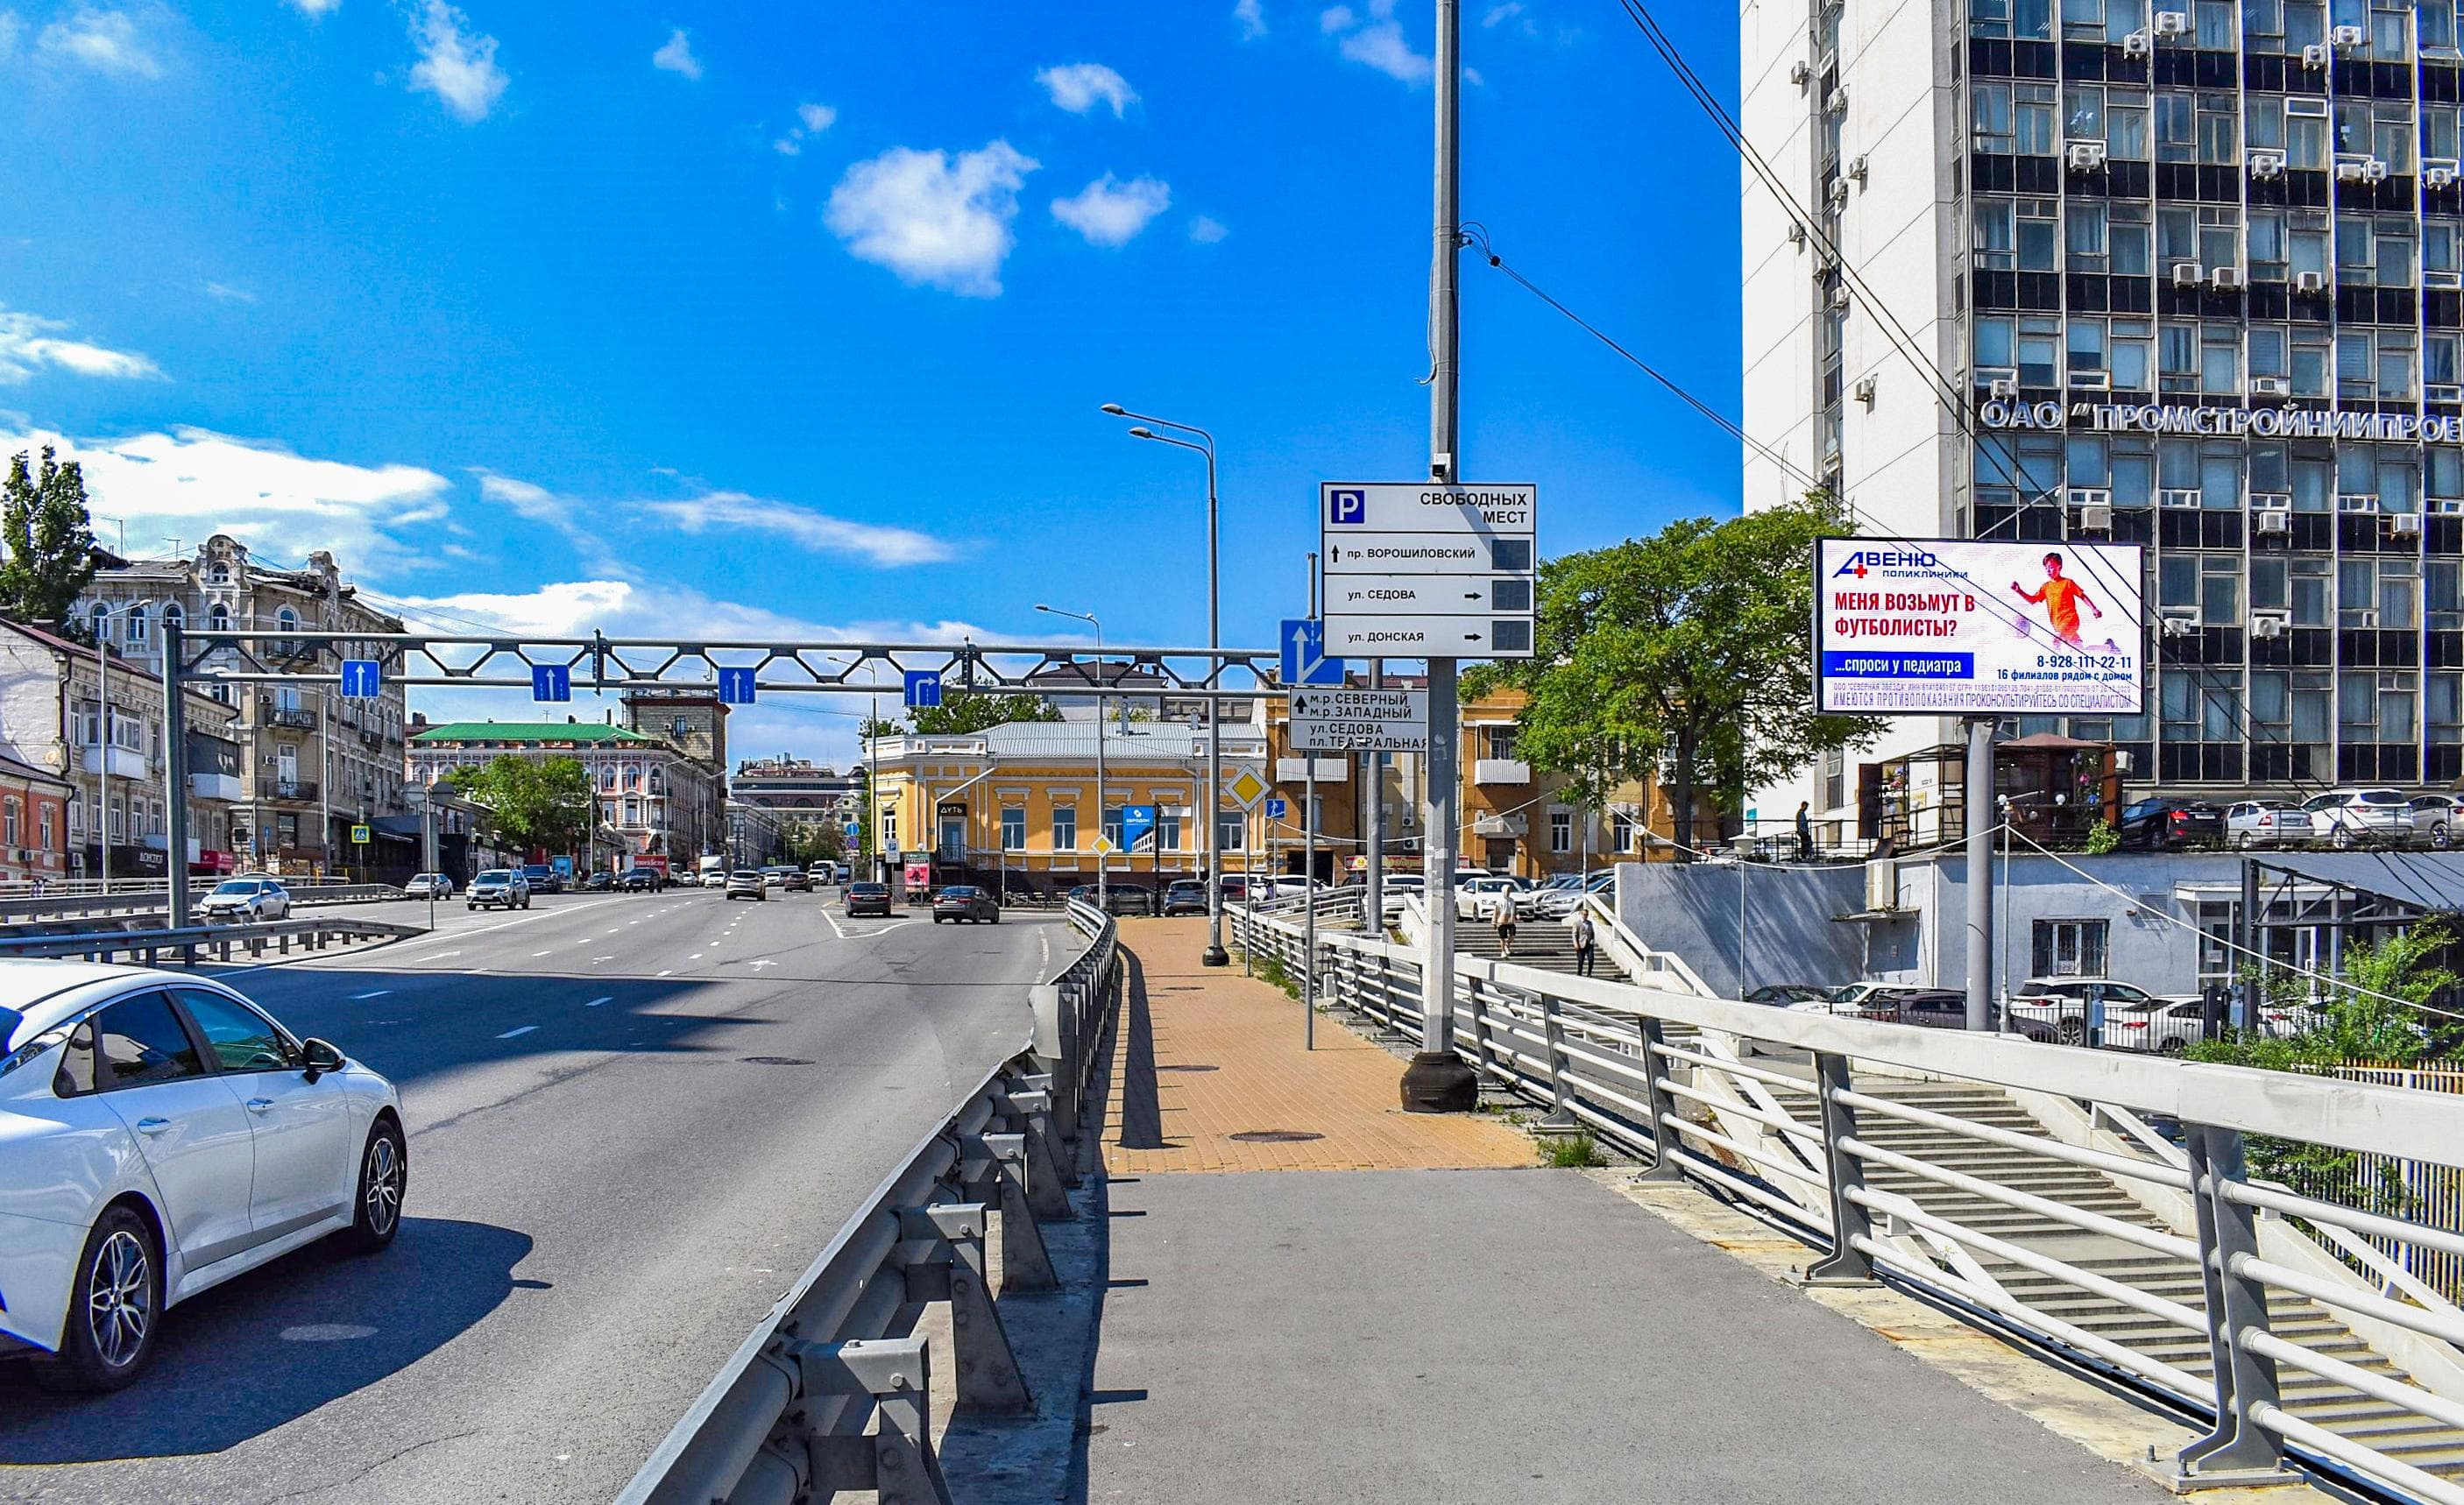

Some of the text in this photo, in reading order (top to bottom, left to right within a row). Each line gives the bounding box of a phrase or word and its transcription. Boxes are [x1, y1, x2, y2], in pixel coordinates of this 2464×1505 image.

[1980, 399, 2464, 442] ОАО "ПРОМСТРОЙНИИПРОЕ
[1338, 493, 1359, 521] P
[1420, 492, 1527, 508] СВОБОДНЫХ
[1483, 511, 1527, 524] МЕСТ
[1347, 547, 1476, 559] пр. ВОРОШИЛОВСКИЙ
[1832, 551, 1937, 579] АВЕНЮ
[1348, 590, 1416, 602] ул. СЕДОВА
[1835, 591, 1975, 614] МЕНЯ ВОЗЬМУТ В
[1835, 616, 1958, 639] ФУТБОЛИСТЫ?
[1348, 632, 1425, 643] ул. ДОНСКАЯ
[1892, 660, 1900, 675] у
[1903, 658, 1962, 676] педиатра
[2036, 655, 2132, 668] 8-928-111-22-11
[1998, 668, 2008, 680] 16
[2011, 669, 2059, 682] филиалов
[2062, 671, 2092, 682] рядом
[2093, 672, 2099, 681] с
[1833, 692, 2131, 710] ИМЕЮТСЯ ПРОТИВОПОКАЗАНИЯ ПРОКОНСУЛЬТИРУЙТЕСЬ СО СПЕЦИАЛИСТОМ
